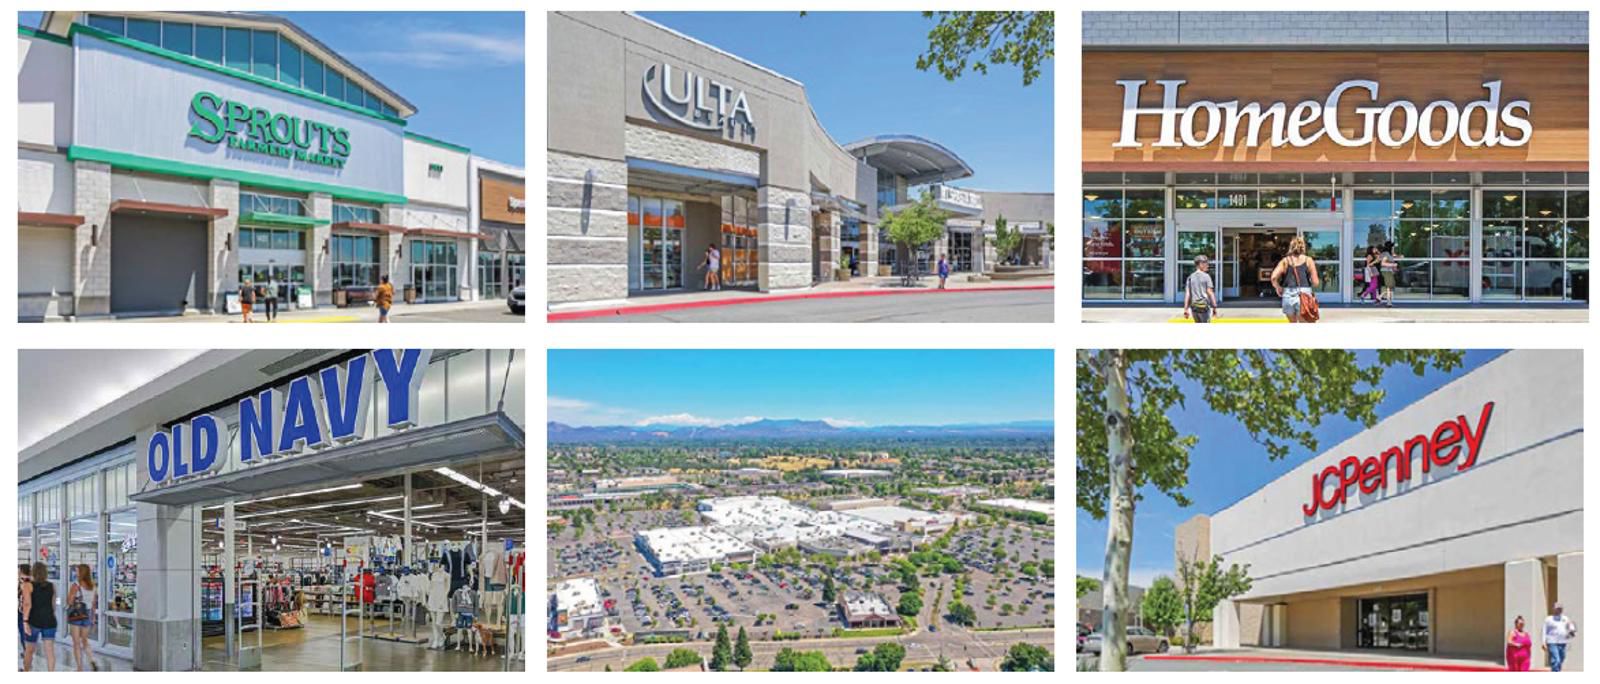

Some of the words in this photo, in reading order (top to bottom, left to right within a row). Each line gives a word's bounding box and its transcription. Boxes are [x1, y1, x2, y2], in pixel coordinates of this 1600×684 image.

[188, 91, 351, 157] SPROUTS
[660, 63, 754, 123] ULTA
[1112, 79, 1533, 148] HomeGoods
[1229, 194, 1247, 207] 1401
[148, 414, 220, 483] OLD
[238, 349, 422, 462] NAVY
[1303, 401, 1495, 517] JCPenney
